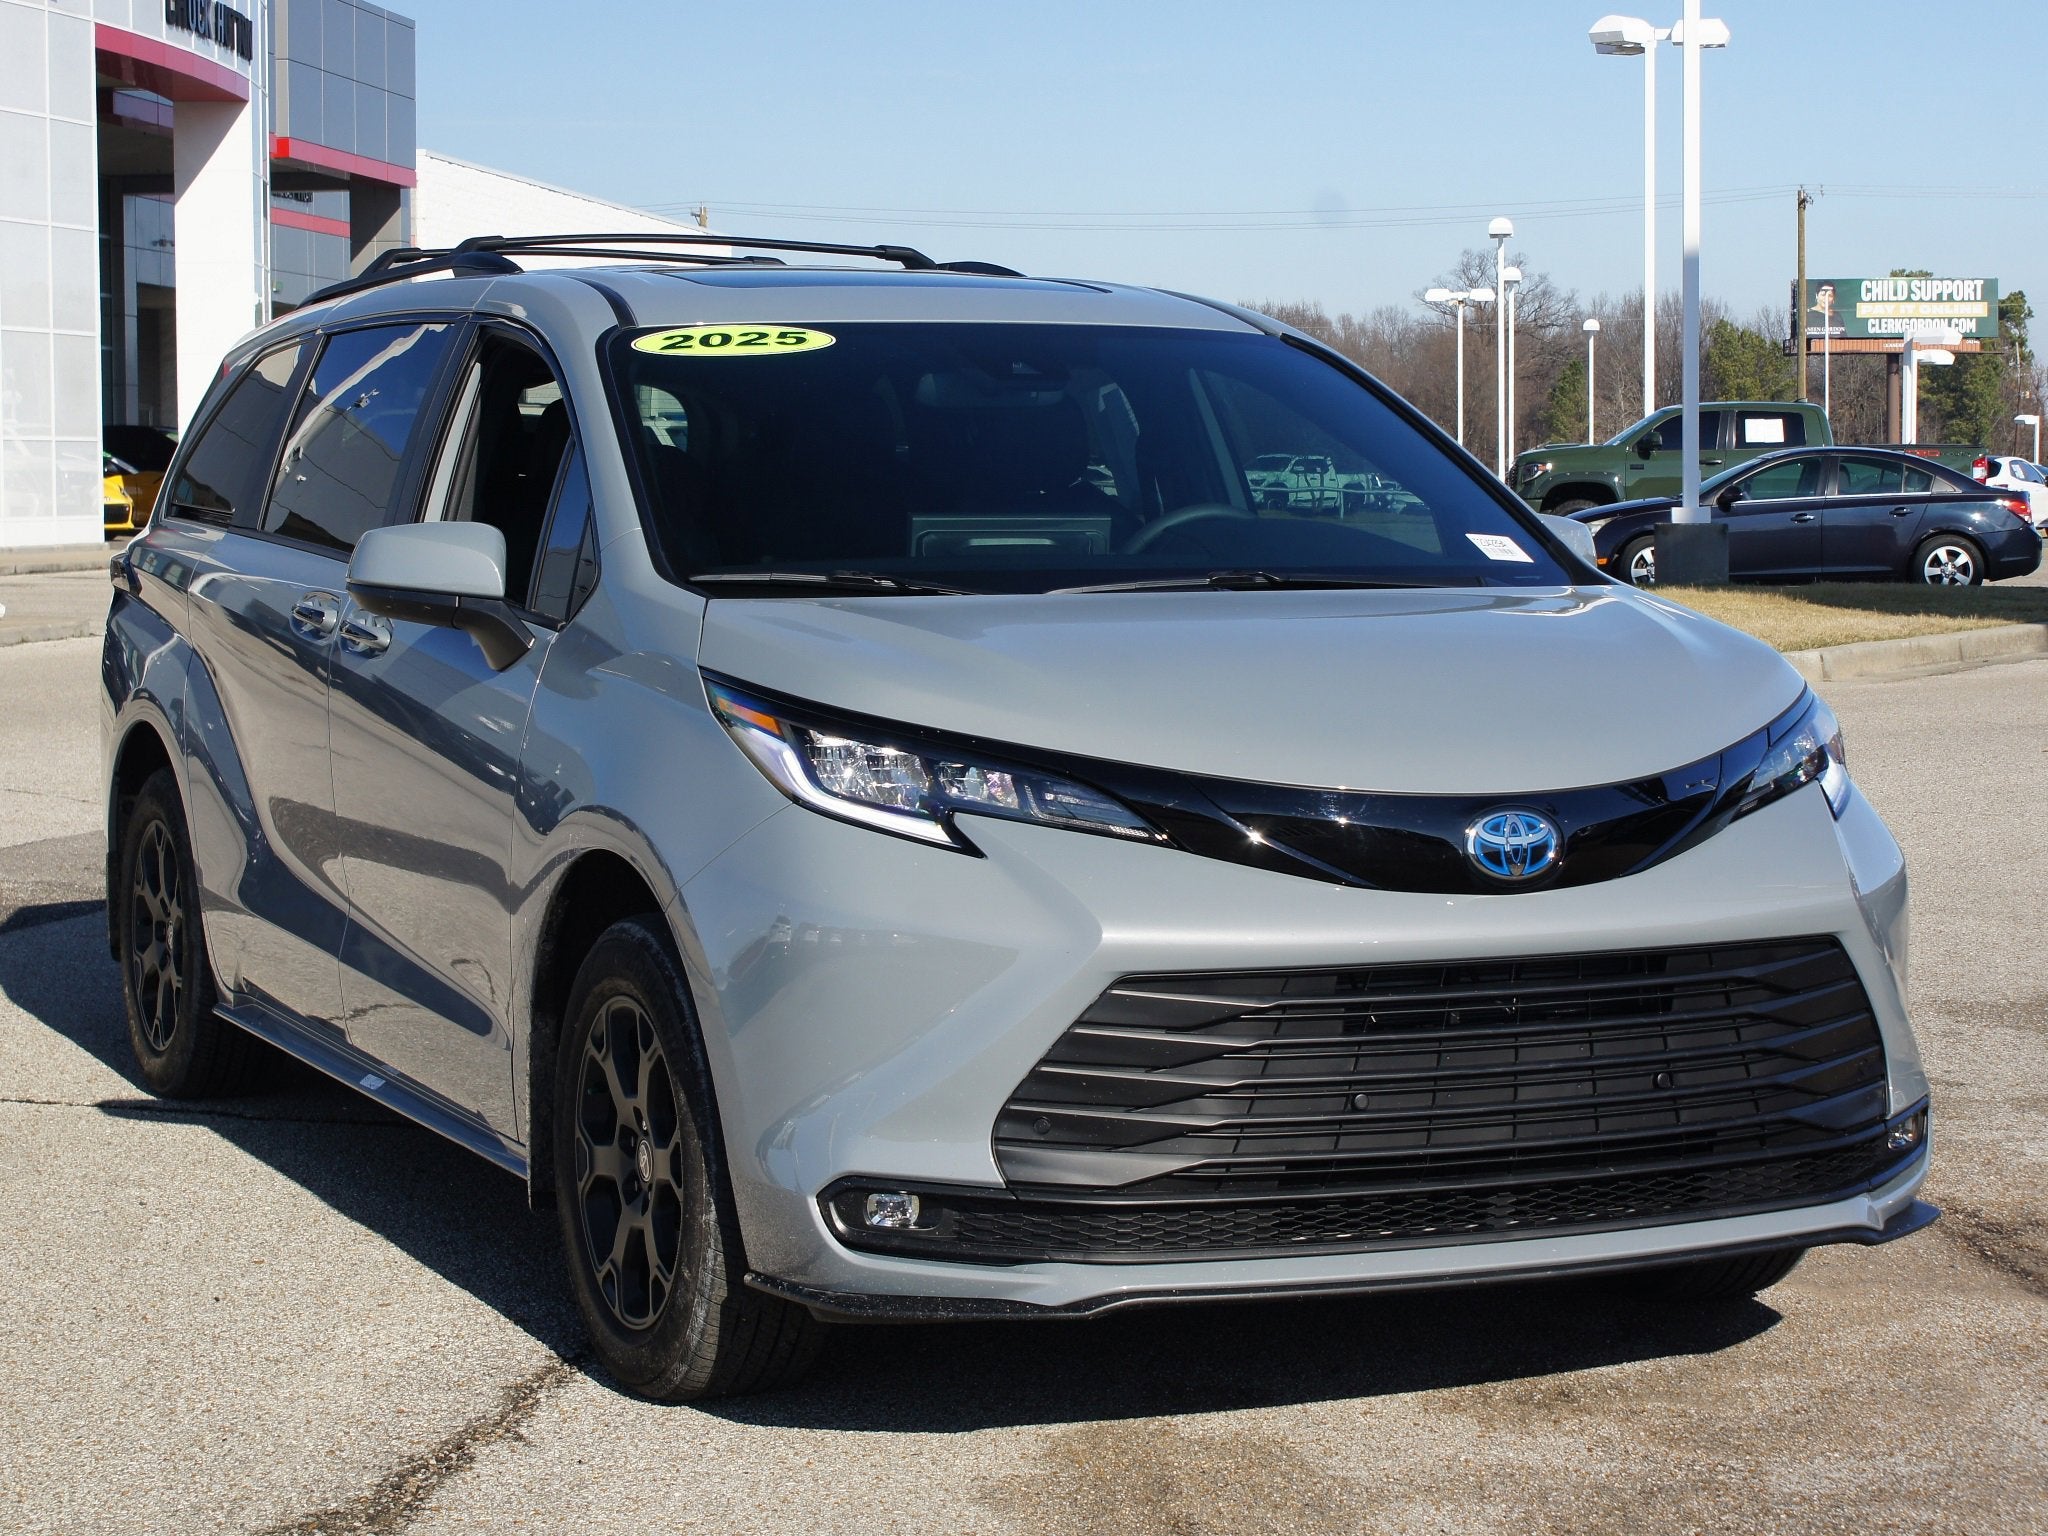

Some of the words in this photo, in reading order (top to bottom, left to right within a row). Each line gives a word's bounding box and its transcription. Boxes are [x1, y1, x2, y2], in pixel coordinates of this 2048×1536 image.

[1861, 280, 1908, 301] CHILD
[1910, 280, 1984, 301] SUPPORT
[1860, 304, 1896, 315] PAY
[1899, 304, 1916, 315] IT
[1918, 304, 1984, 315] ONLINE
[1867, 318, 1976, 334] CLERKGORDONCOM
[658, 331, 809, 351] 2025
